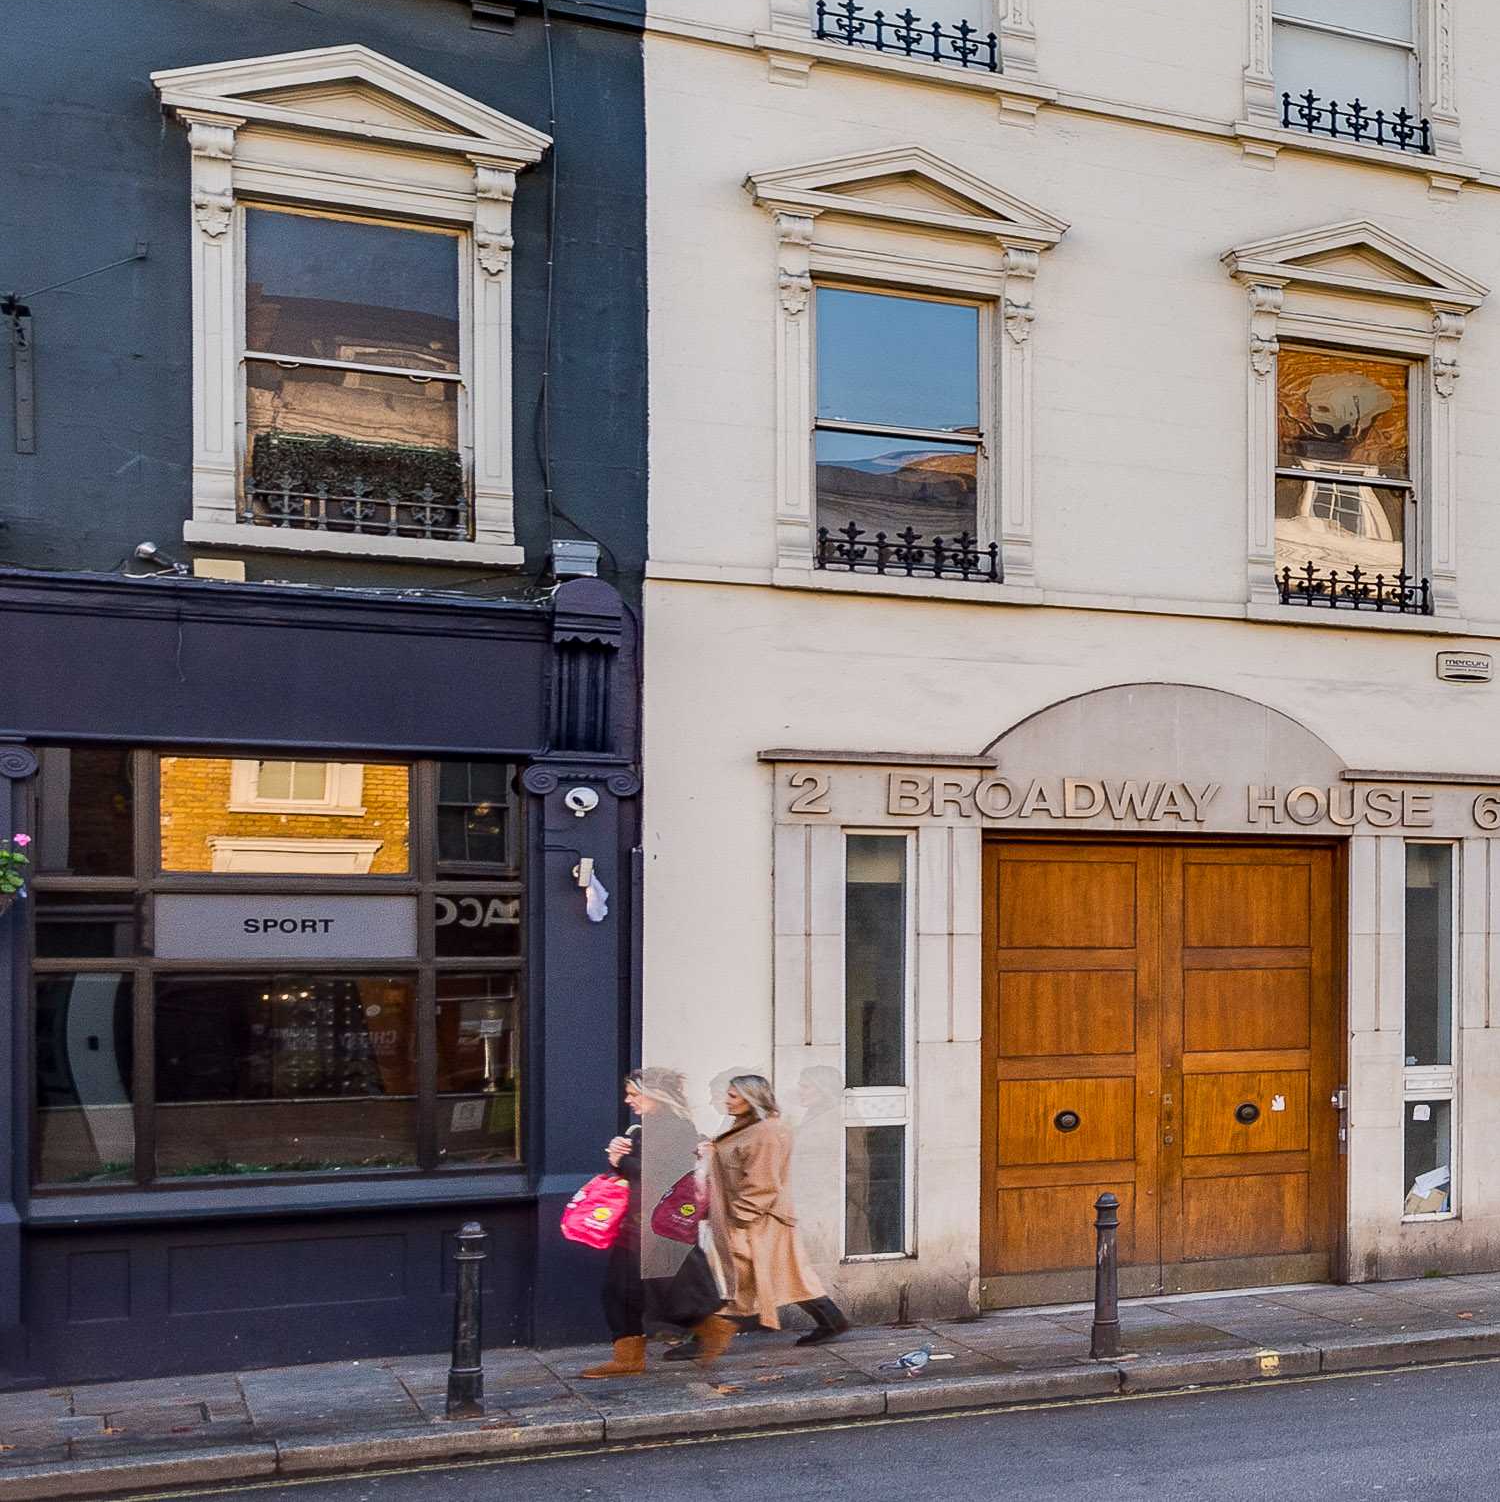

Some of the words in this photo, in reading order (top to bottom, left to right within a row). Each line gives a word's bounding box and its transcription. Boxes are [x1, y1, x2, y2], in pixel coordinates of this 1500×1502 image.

[791, 772, 832, 815] 2
[888, 773, 1221, 824] BROADWAY
[1247, 784, 1434, 830] HOUSE
[243, 918, 335, 934] SPORT
